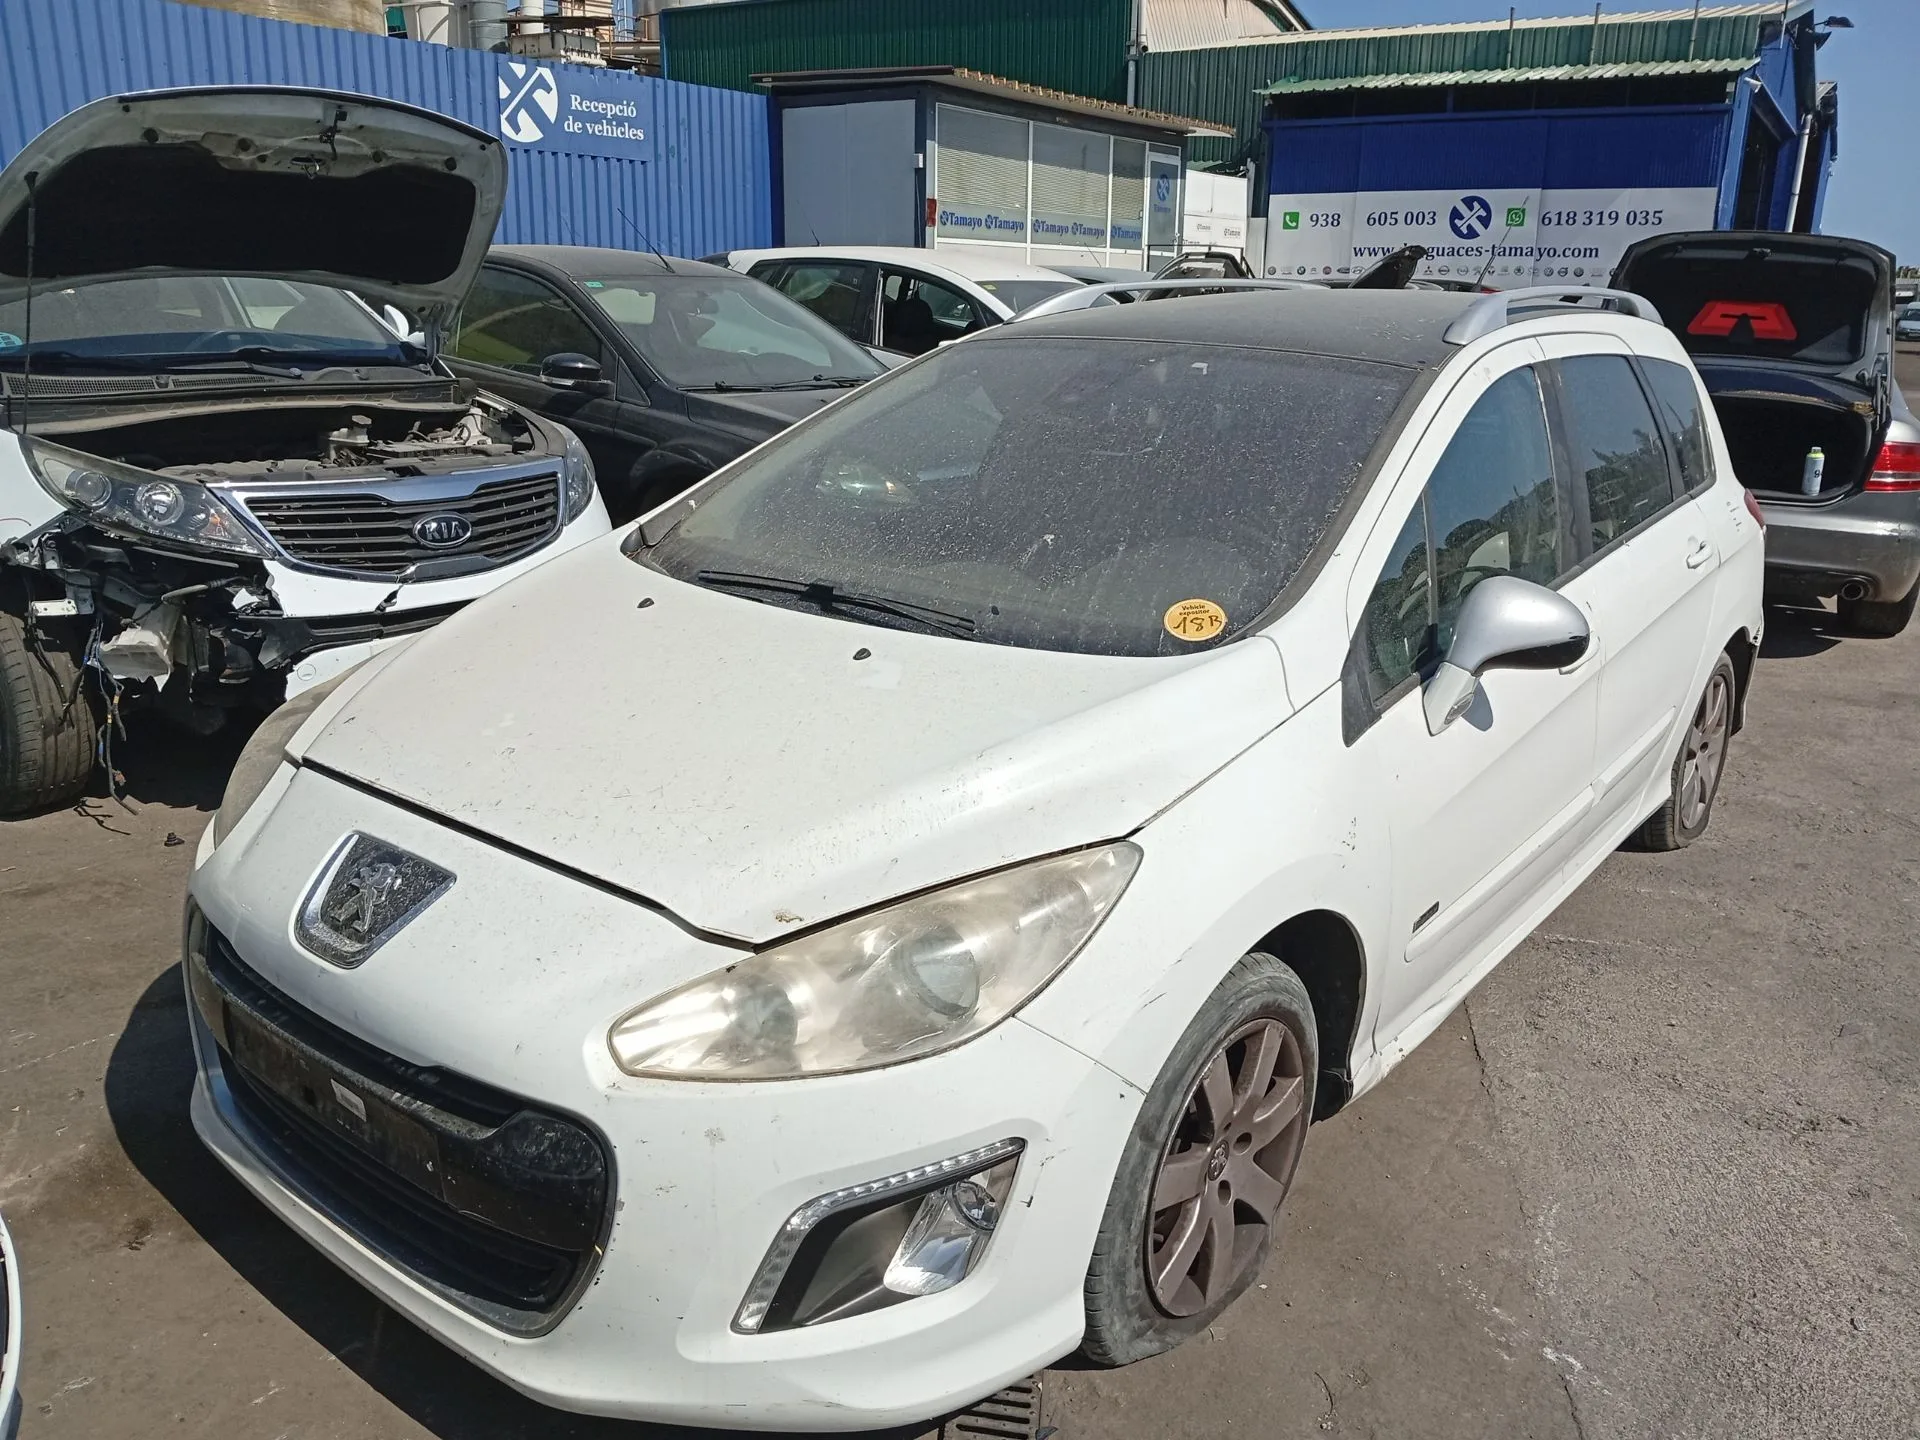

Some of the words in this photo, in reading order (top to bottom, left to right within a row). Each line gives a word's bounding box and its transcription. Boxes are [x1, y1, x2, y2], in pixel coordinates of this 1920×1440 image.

[570, 94, 637, 118] Recepció
[564, 116, 583, 133] de
[586, 120, 644, 140] vehicles
[949, 212, 982, 231] Tamayo
[994, 216, 1024, 233] Tamayo
[1310, 213, 1341, 228] 938
[1366, 211, 1399, 226] 605
[1404, 211, 1437, 226] 003
[1541, 210, 1577, 226] 618
[1582, 210, 1619, 226] 319
[1626, 210, 1663, 226] 035
[1041, 221, 1069, 236] Tamayo
[1079, 223, 1105, 239] Tamayo
[1117, 226, 1141, 241] Tamayo
[1353, 243, 1599, 261] wwwguaces-tamayo.com
[425, 521, 464, 540] KIA
